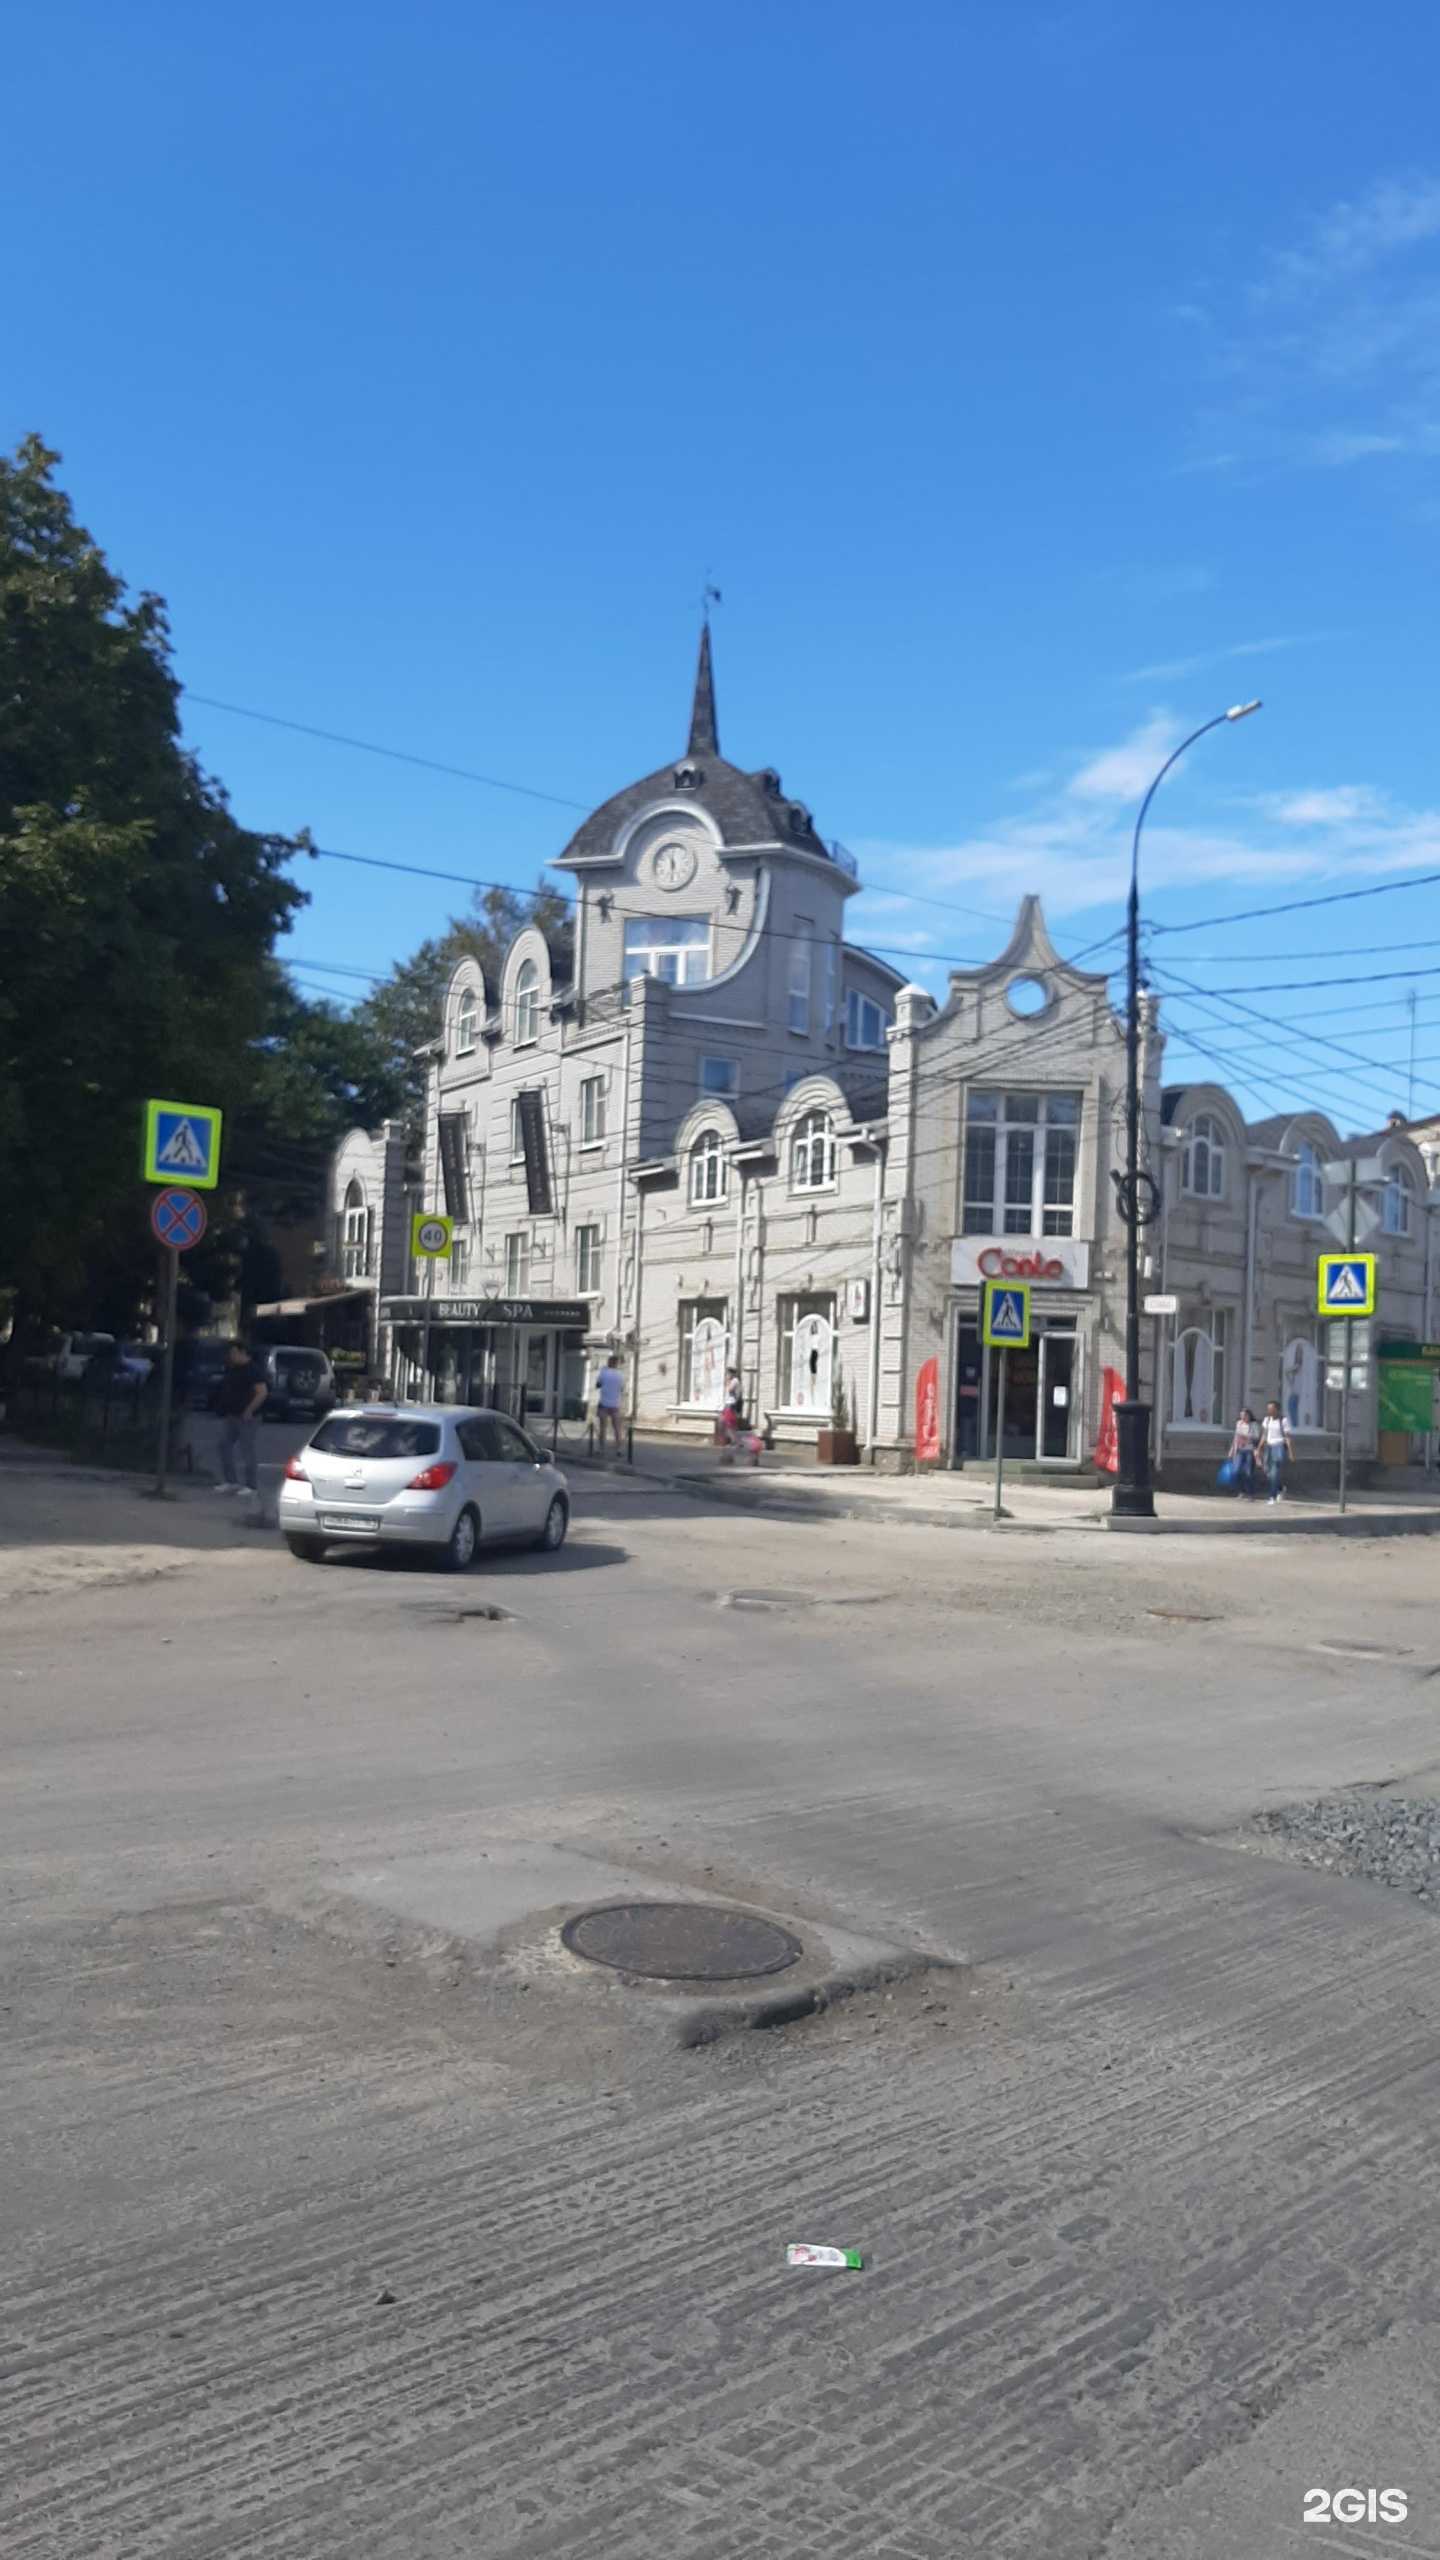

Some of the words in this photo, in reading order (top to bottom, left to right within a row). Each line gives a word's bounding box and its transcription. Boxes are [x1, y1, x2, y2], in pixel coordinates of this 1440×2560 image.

[423, 1230, 442, 1242] 40
[438, 1303, 481, 1318] BEAUTY
[503, 1303, 534, 1319] SPA
